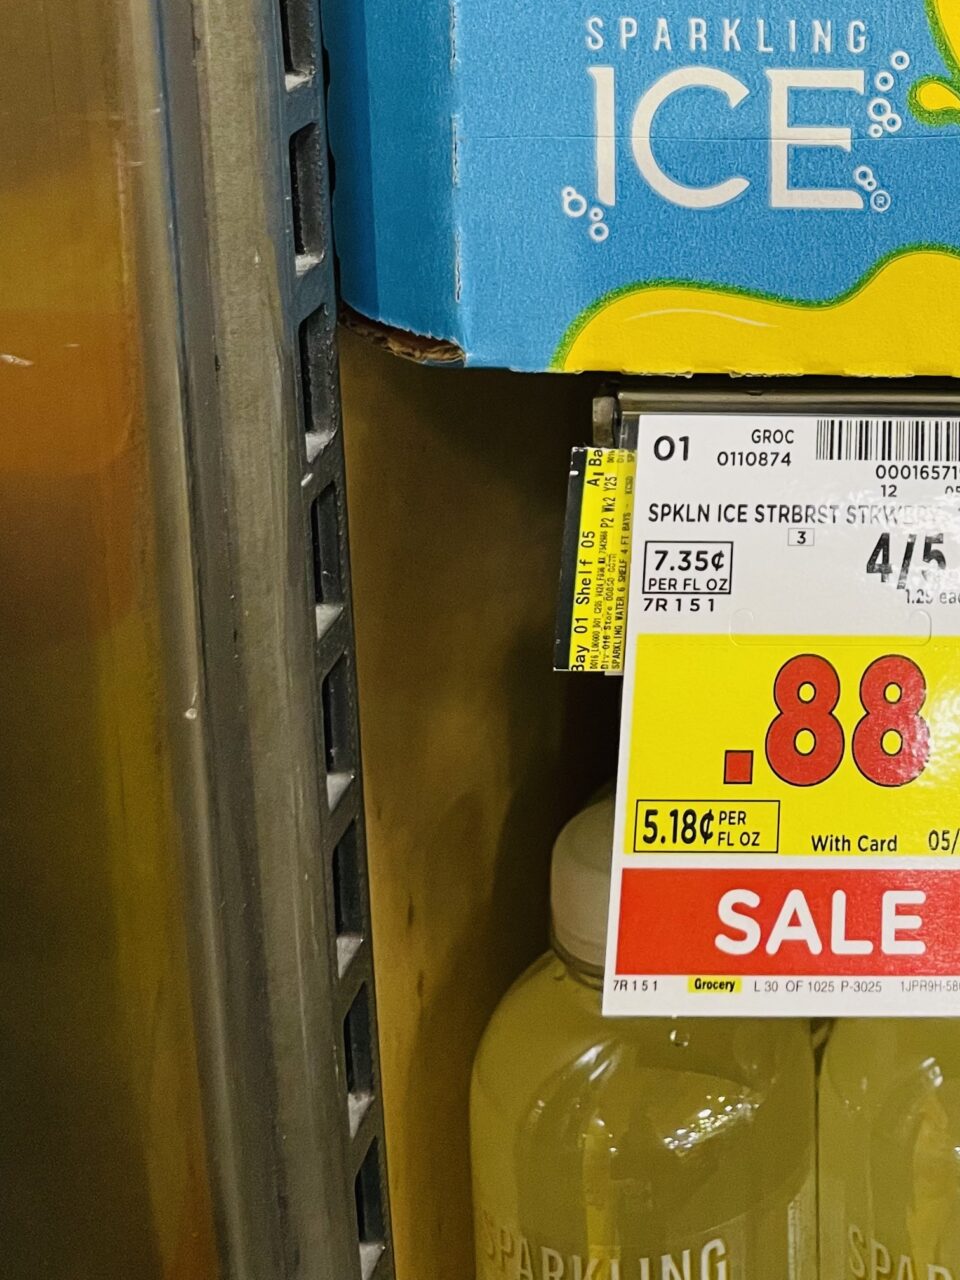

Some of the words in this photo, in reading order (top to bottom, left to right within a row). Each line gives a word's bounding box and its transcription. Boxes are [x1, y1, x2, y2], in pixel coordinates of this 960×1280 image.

[585, 16, 867, 53] SPARKLING
[586, 66, 865, 209] ICE
[751, 429, 795, 445] GROC
[653, 435, 690, 461] 01
[717, 452, 792, 468] 0110874
[880, 485, 898, 498] 12
[648, 504, 709, 523] SPKLN
[717, 504, 748, 523] ICE
[755, 504, 838, 524] STRBRST
[580, 530, 595, 549] 05
[796, 531, 806, 545] 3
[653, 550, 725, 573] 7.35¢
[575, 559, 593, 605] Shelf
[648, 577, 680, 592] PER
[683, 577, 702, 592] FL
[706, 577, 729, 592] OZ
[643, 598, 668, 613] 7R
[574, 617, 589, 634] 01
[611, 625, 624, 670] SPARKLING
[571, 644, 590, 672] Bay
[642, 808, 714, 846] 5.18¢
[718, 810, 747, 826] PER
[717, 831, 735, 847] FL
[739, 831, 761, 847] OZ
[811, 834, 852, 853] With
[857, 834, 898, 853] Card
[714, 888, 927, 956] SALE
[613, 980, 628, 992] 7R
[694, 977, 736, 993] Grocery
[764, 981, 779, 992] 30
[785, 981, 803, 992] OF
[808, 981, 835, 993] 1025
[840, 981, 882, 993] P-3025
